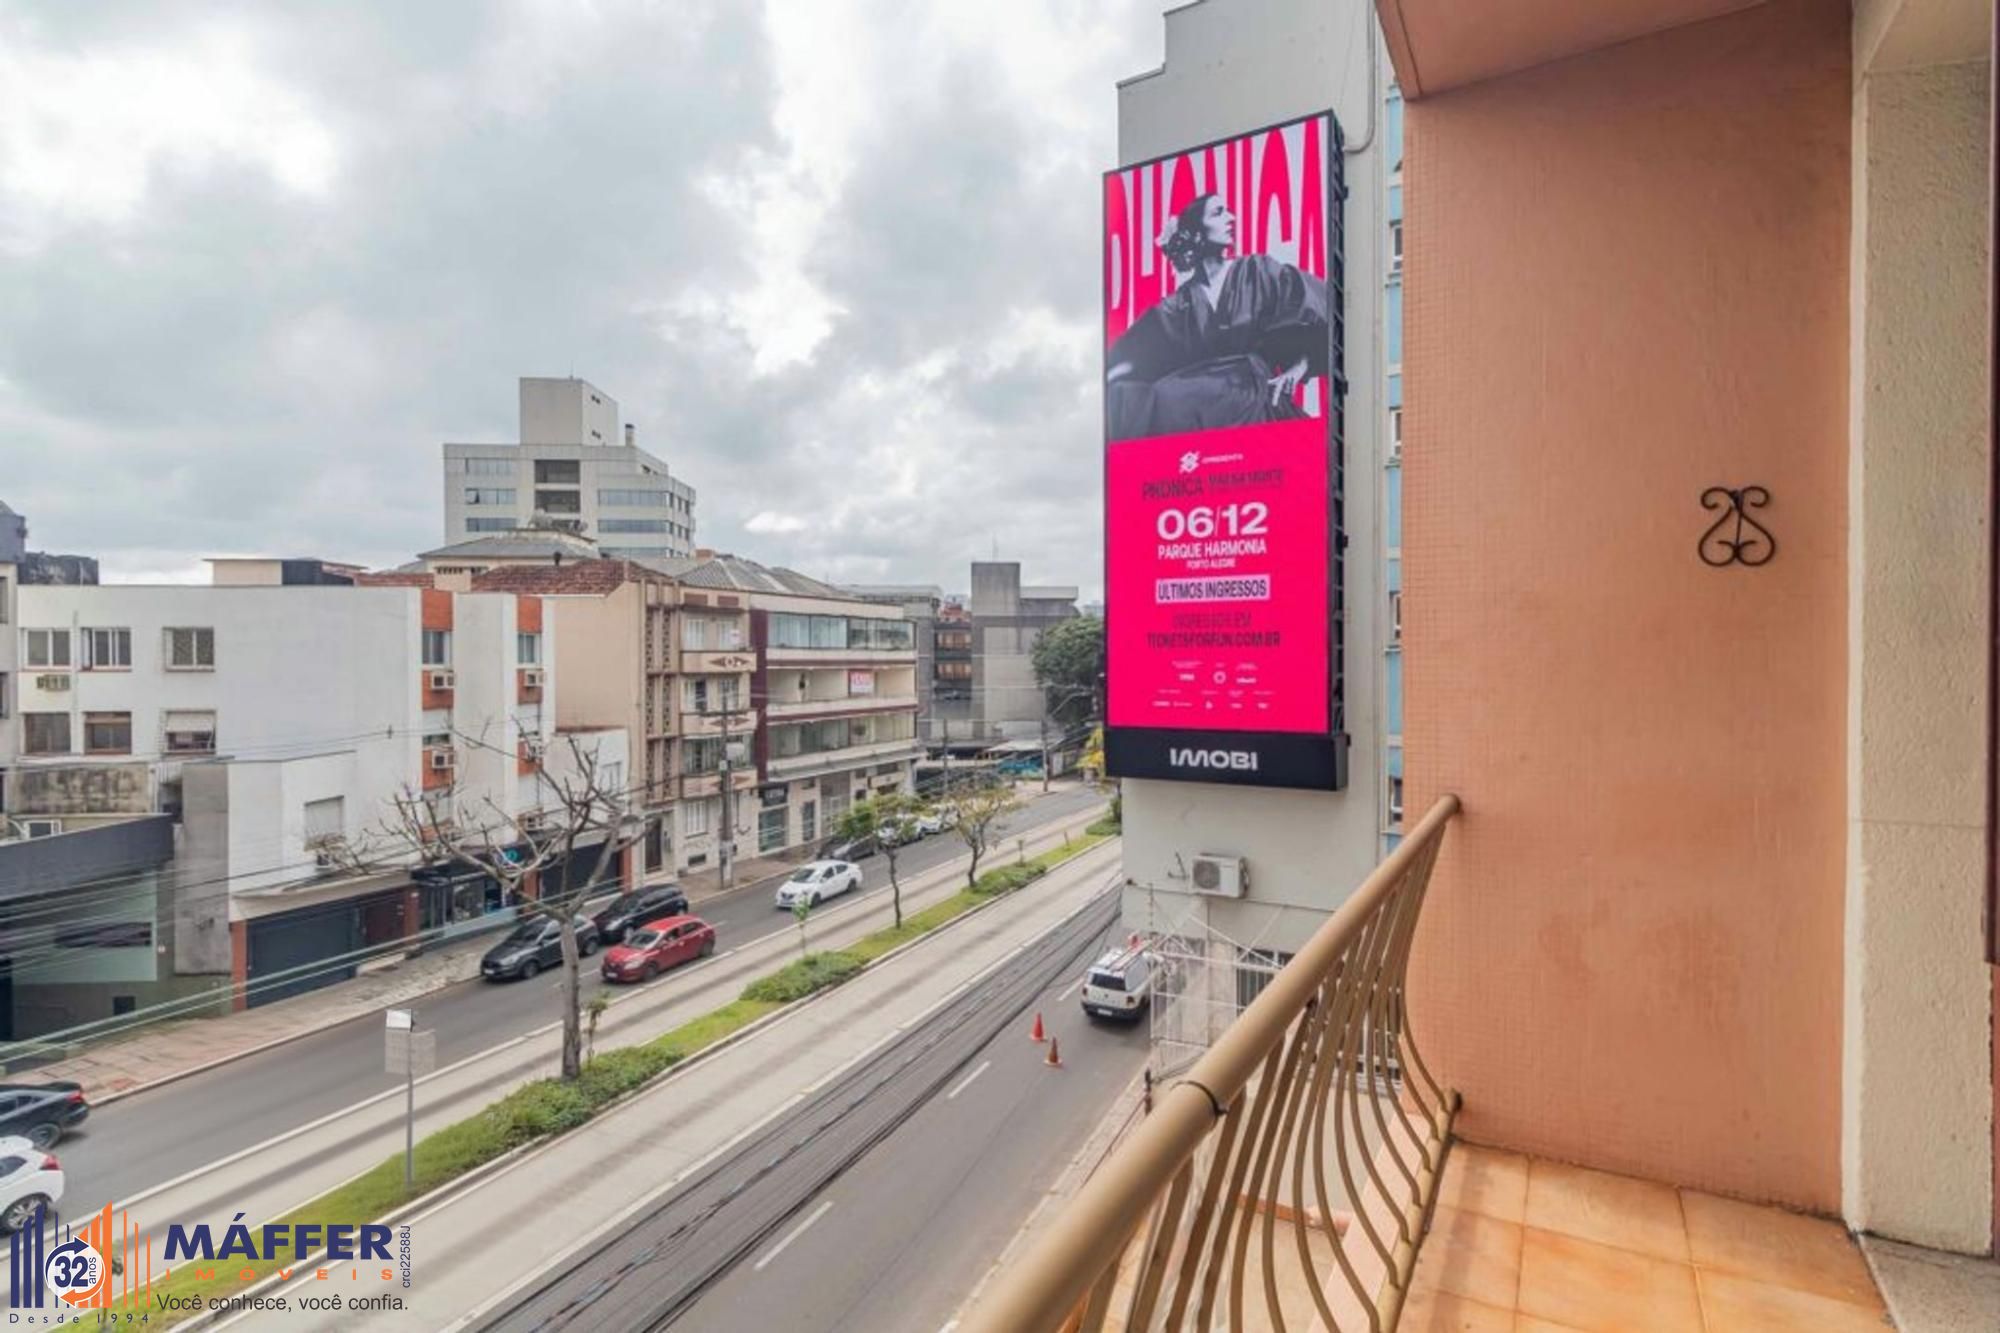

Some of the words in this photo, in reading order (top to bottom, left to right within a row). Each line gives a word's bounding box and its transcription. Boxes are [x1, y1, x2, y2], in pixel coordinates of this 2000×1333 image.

[1156, 502, 1269, 541] 06/12
[1158, 542, 1202, 560] PARQUE
[1204, 538, 1267, 558] HARMONIA
[1205, 579, 1267, 599] INGRESSOS
[1169, 747, 1259, 771] IMOBI
